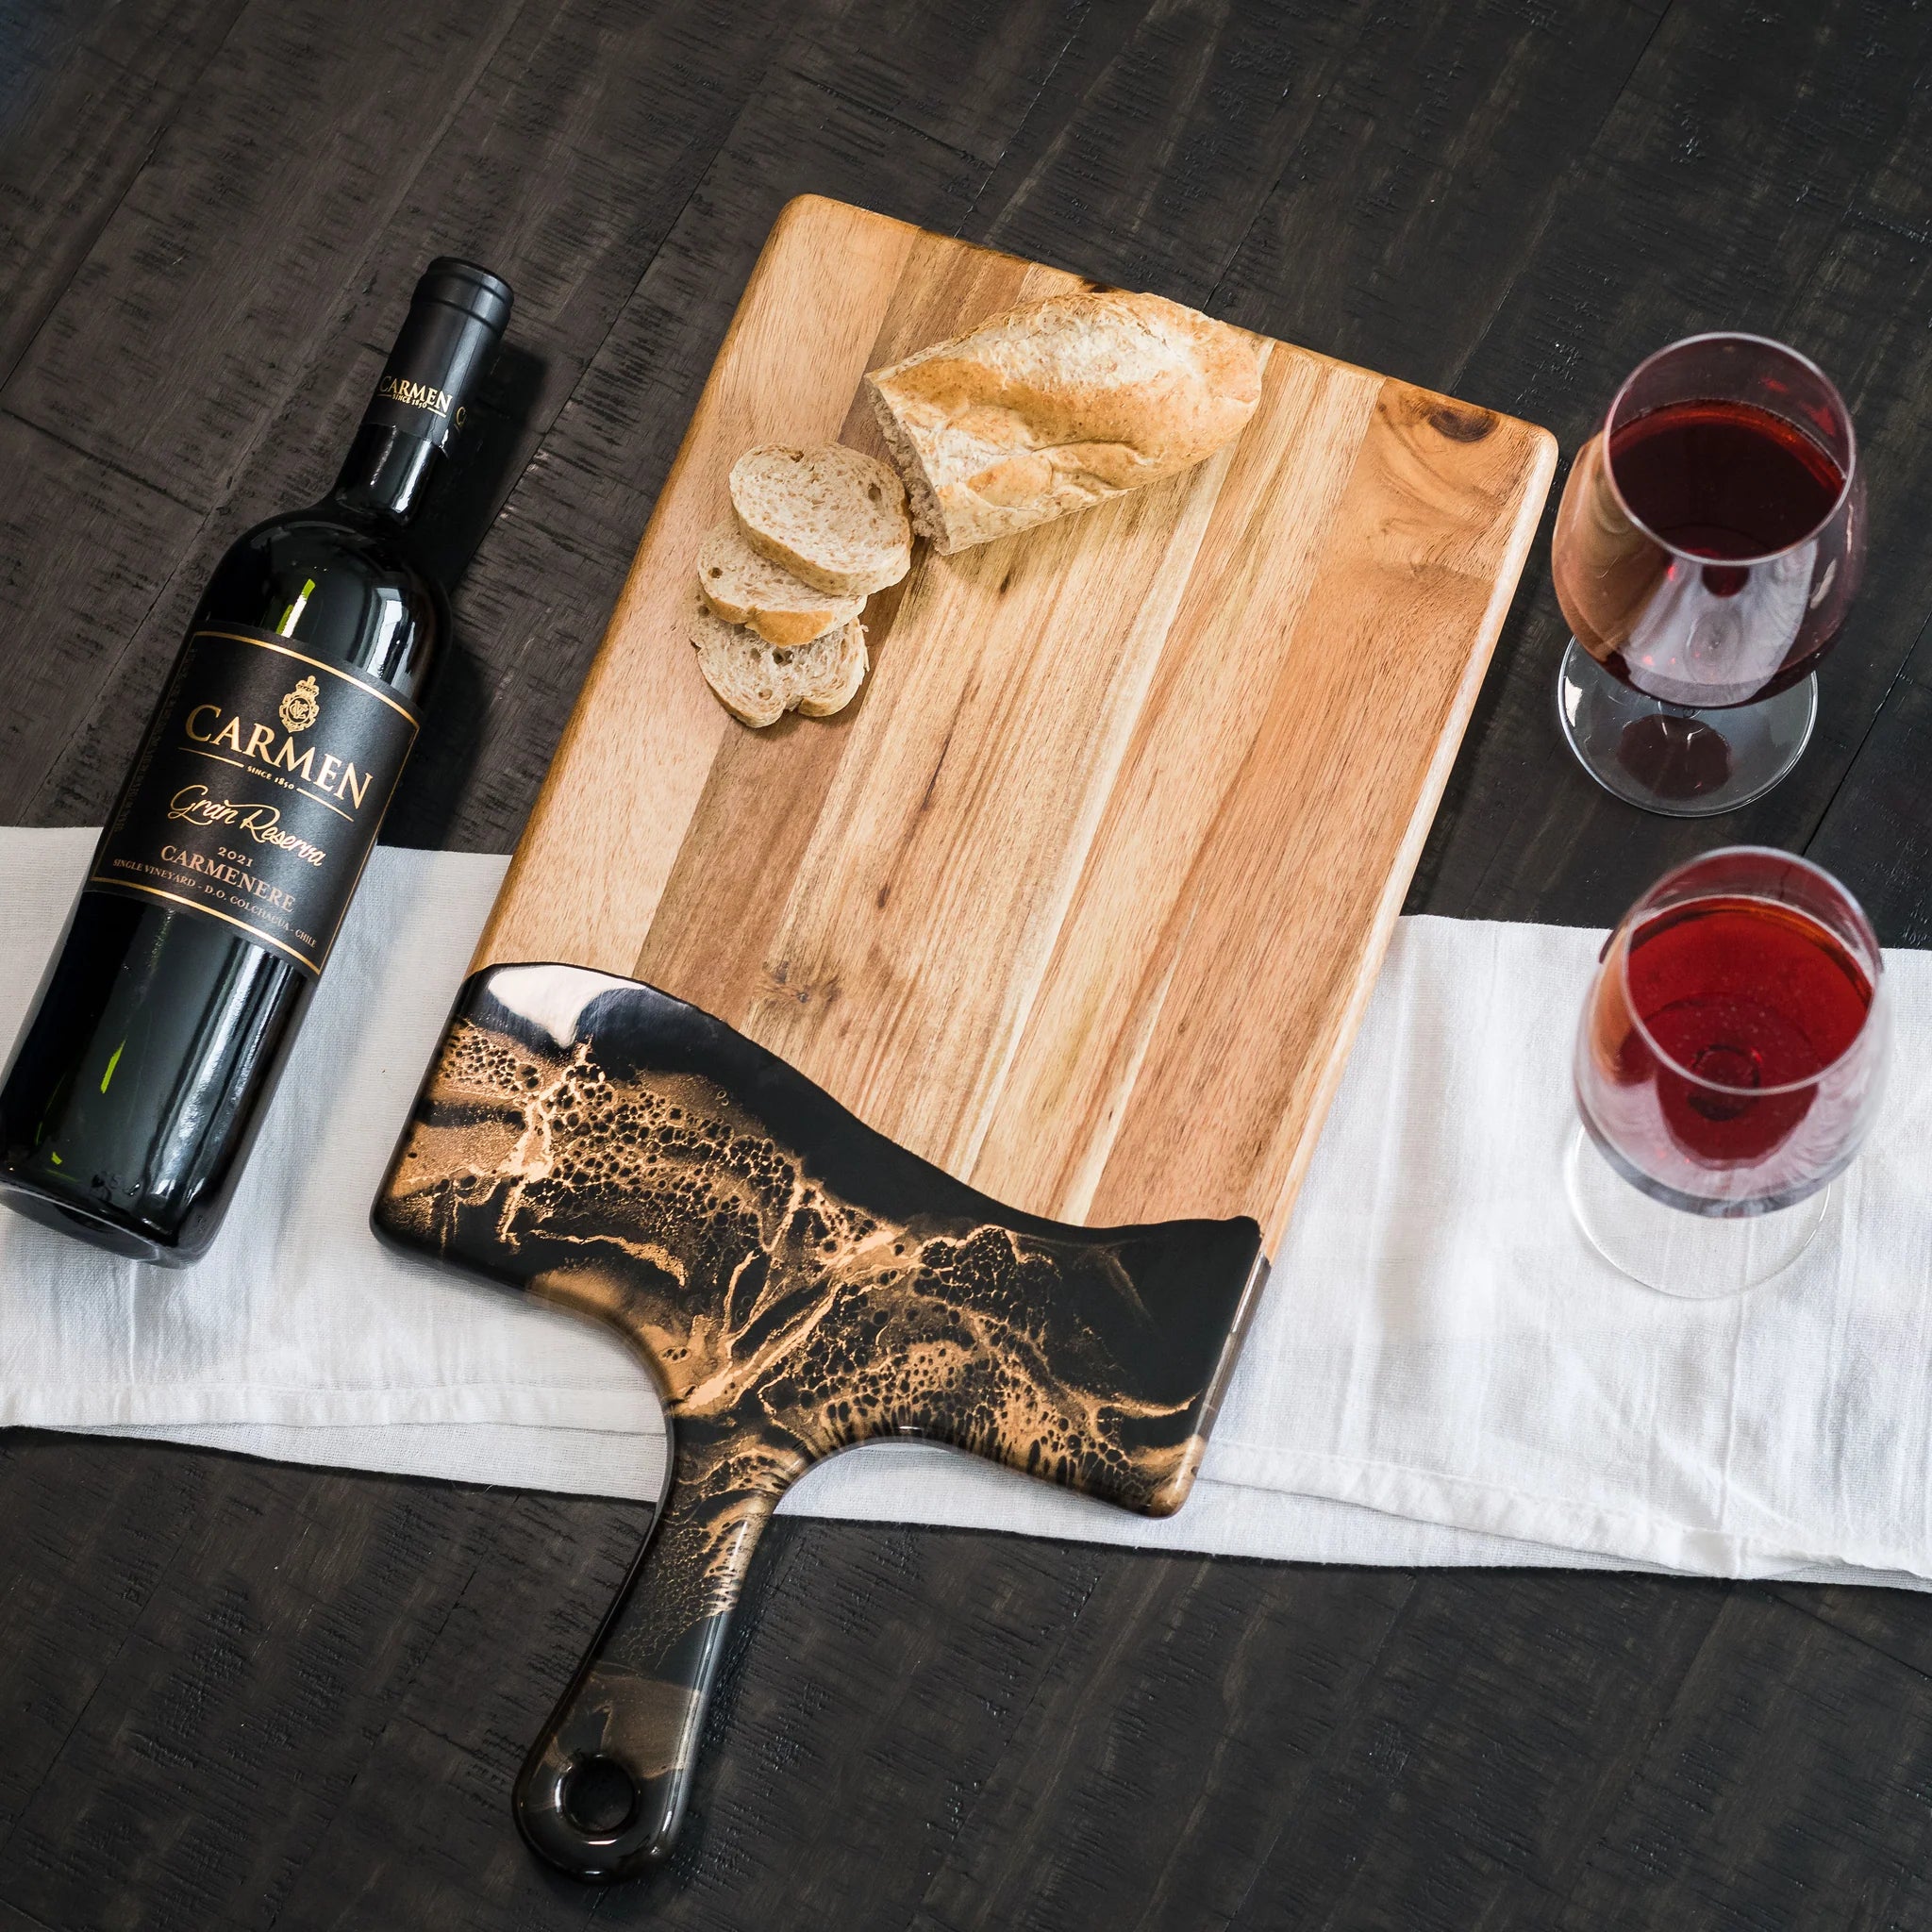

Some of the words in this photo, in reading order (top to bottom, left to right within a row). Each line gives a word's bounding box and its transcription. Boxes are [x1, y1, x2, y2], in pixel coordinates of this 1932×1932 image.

[379, 375, 453, 413] CARMEN
[392, 393, 410, 404] SINCE
[411, 399, 427, 408] 1850
[186, 704, 374, 809] CARMEN
[247, 765, 272, 780] SINCE
[275, 776, 295, 791] 1850
[167, 784, 239, 825] Gran
[224, 800, 326, 866] Reserva
[161, 845, 296, 913] CARMENERE
[218, 846, 254, 868] 2021
[113, 858, 142, 872] SINGLE
[143, 865, 196, 887] VINEYARD
[204, 885, 226, 901] D.O.
[229, 895, 290, 931] COLCHAGUA
[295, 928, 317, 948] CHILE
